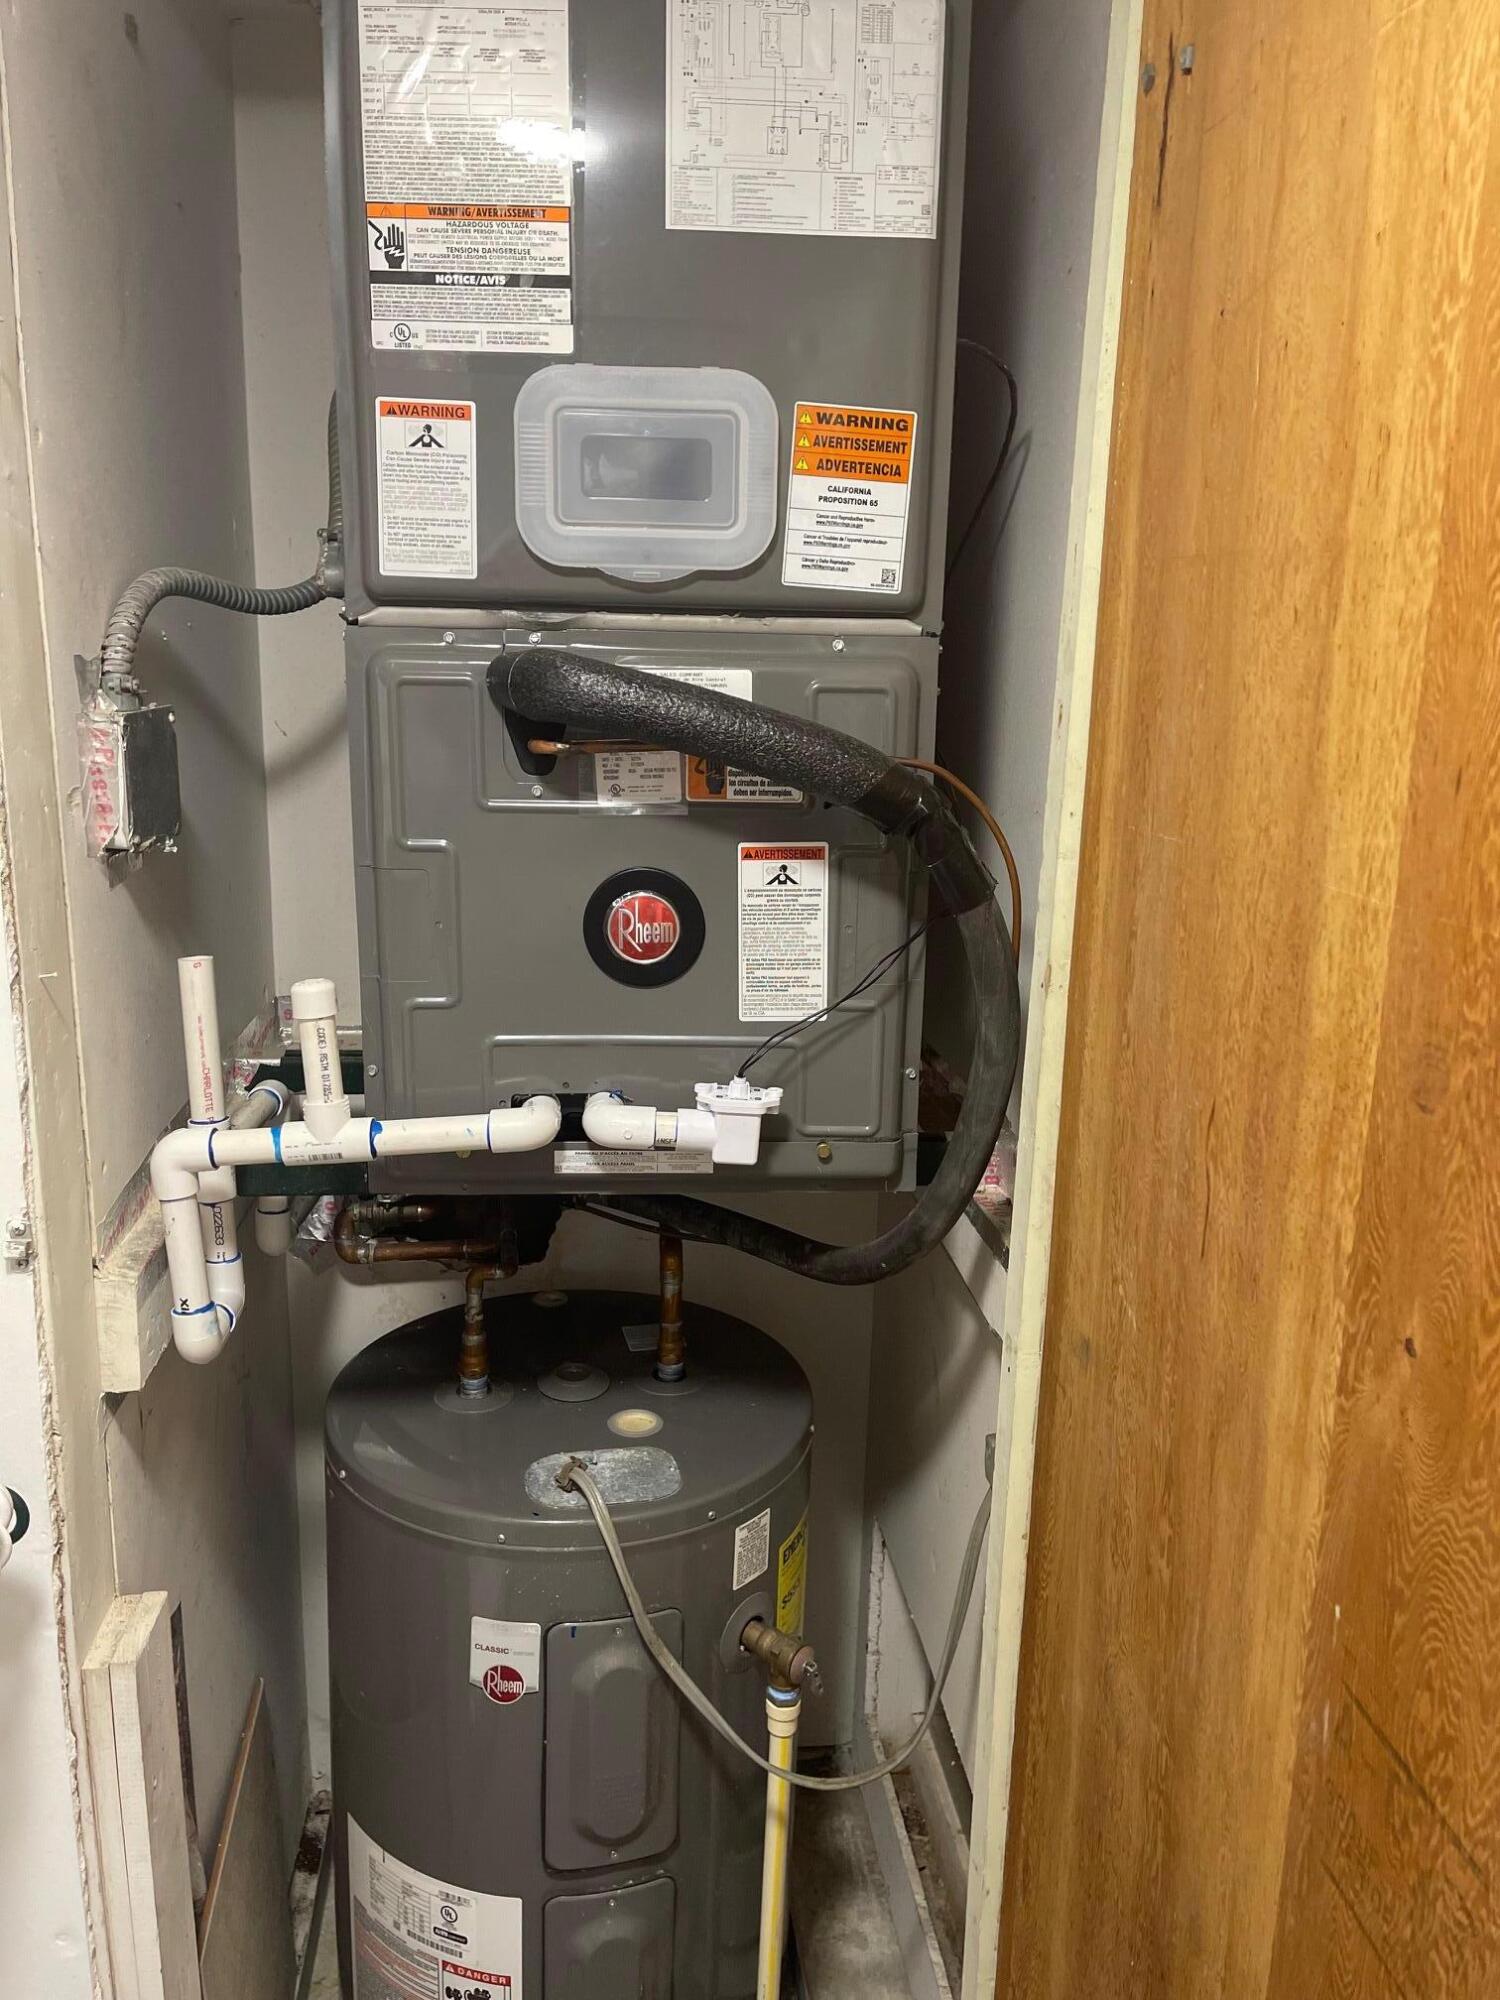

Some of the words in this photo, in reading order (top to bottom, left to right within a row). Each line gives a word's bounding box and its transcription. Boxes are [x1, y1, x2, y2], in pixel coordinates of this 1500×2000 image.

[446, 221, 494, 229] HAZARDOUS
[481, 247, 531, 255] DANGEREUSE
[435, 274, 507, 286] NOTICE/AVIS
[398, 404, 465, 419] WARNING
[816, 412, 909, 432] WARNING
[813, 434, 908, 455] AVERTISSEMENT
[816, 458, 902, 477] ADVERTENCIA
[827, 485, 872, 496] CALIFORNIA
[818, 495, 867, 507] PROPOSITION
[869, 499, 879, 507] 65
[754, 849, 822, 860] AVERTISSEMENT
[619, 898, 674, 953] Rheem
[202, 1067, 214, 1113] CHARLOTTE
[474, 1643, 510, 1655] CLASSIC
[487, 1666, 523, 1698] Rheem
[457, 1966, 507, 1985] DANGER
